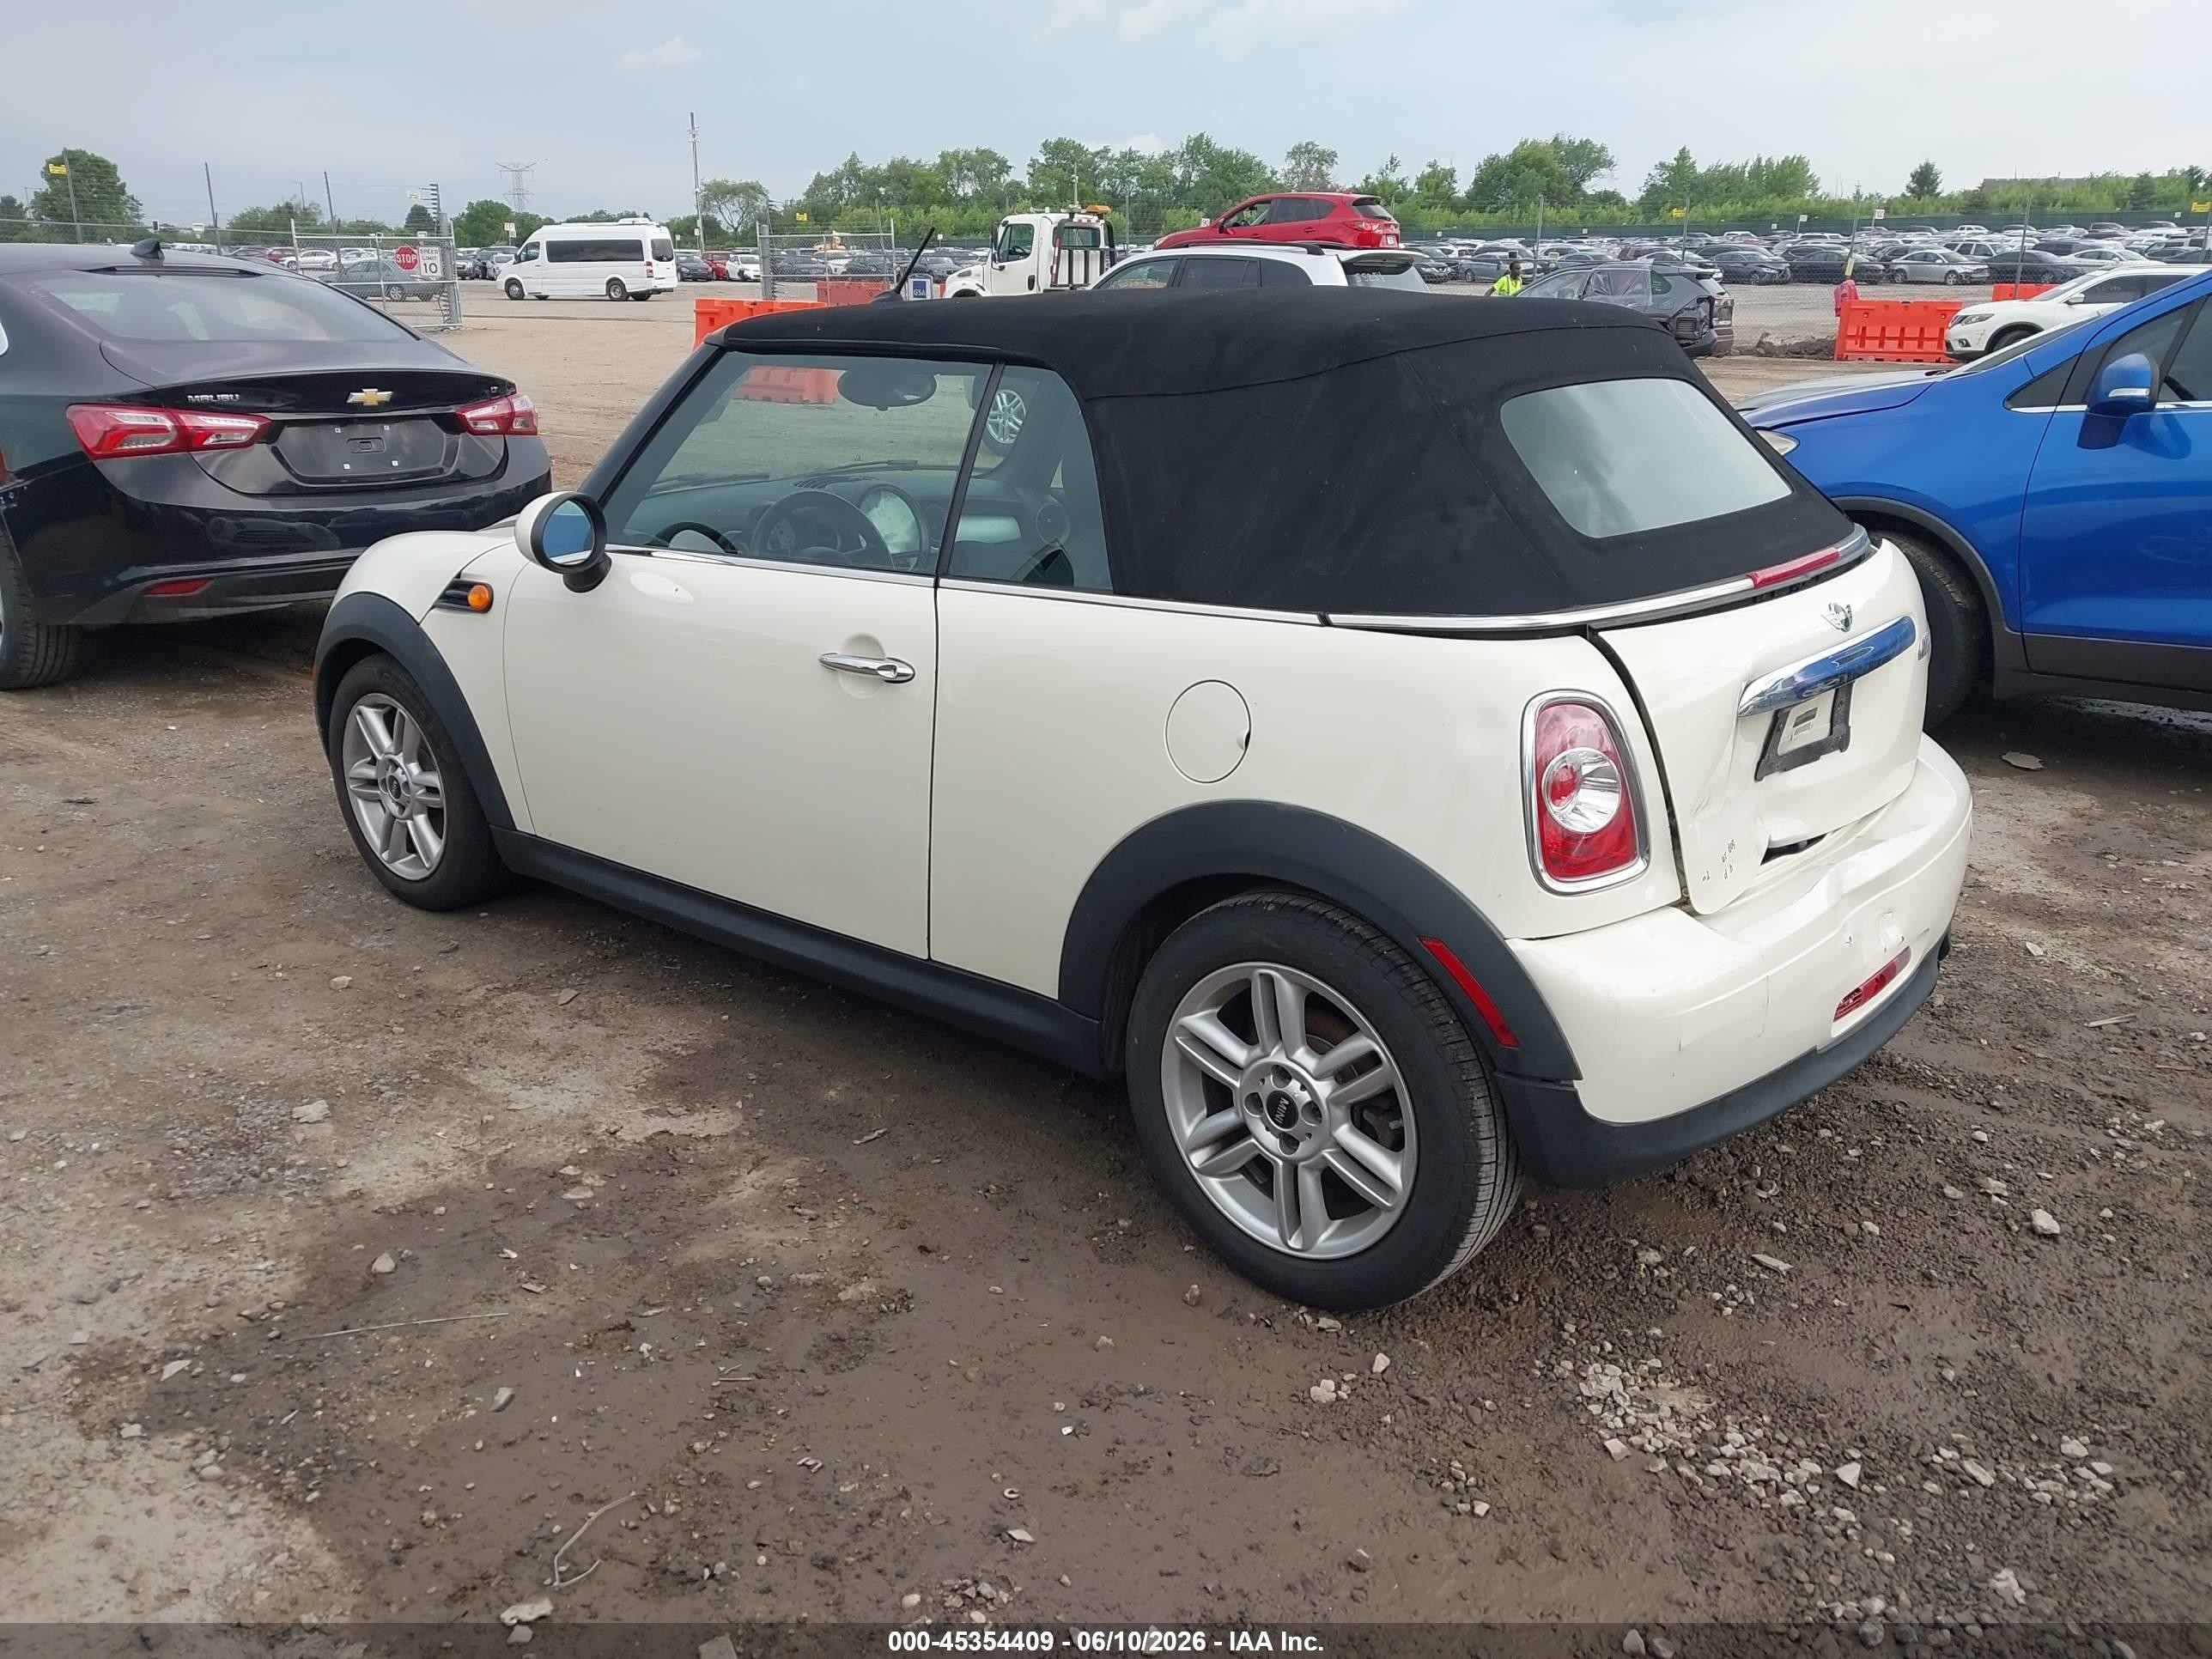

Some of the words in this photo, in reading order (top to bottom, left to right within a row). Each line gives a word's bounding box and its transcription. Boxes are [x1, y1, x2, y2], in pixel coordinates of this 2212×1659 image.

[396, 253, 416, 263] STOP
[423, 262, 438, 274] 10
[187, 393, 240, 403] MALIBU
[1274, 1097, 1290, 1125] MINI
